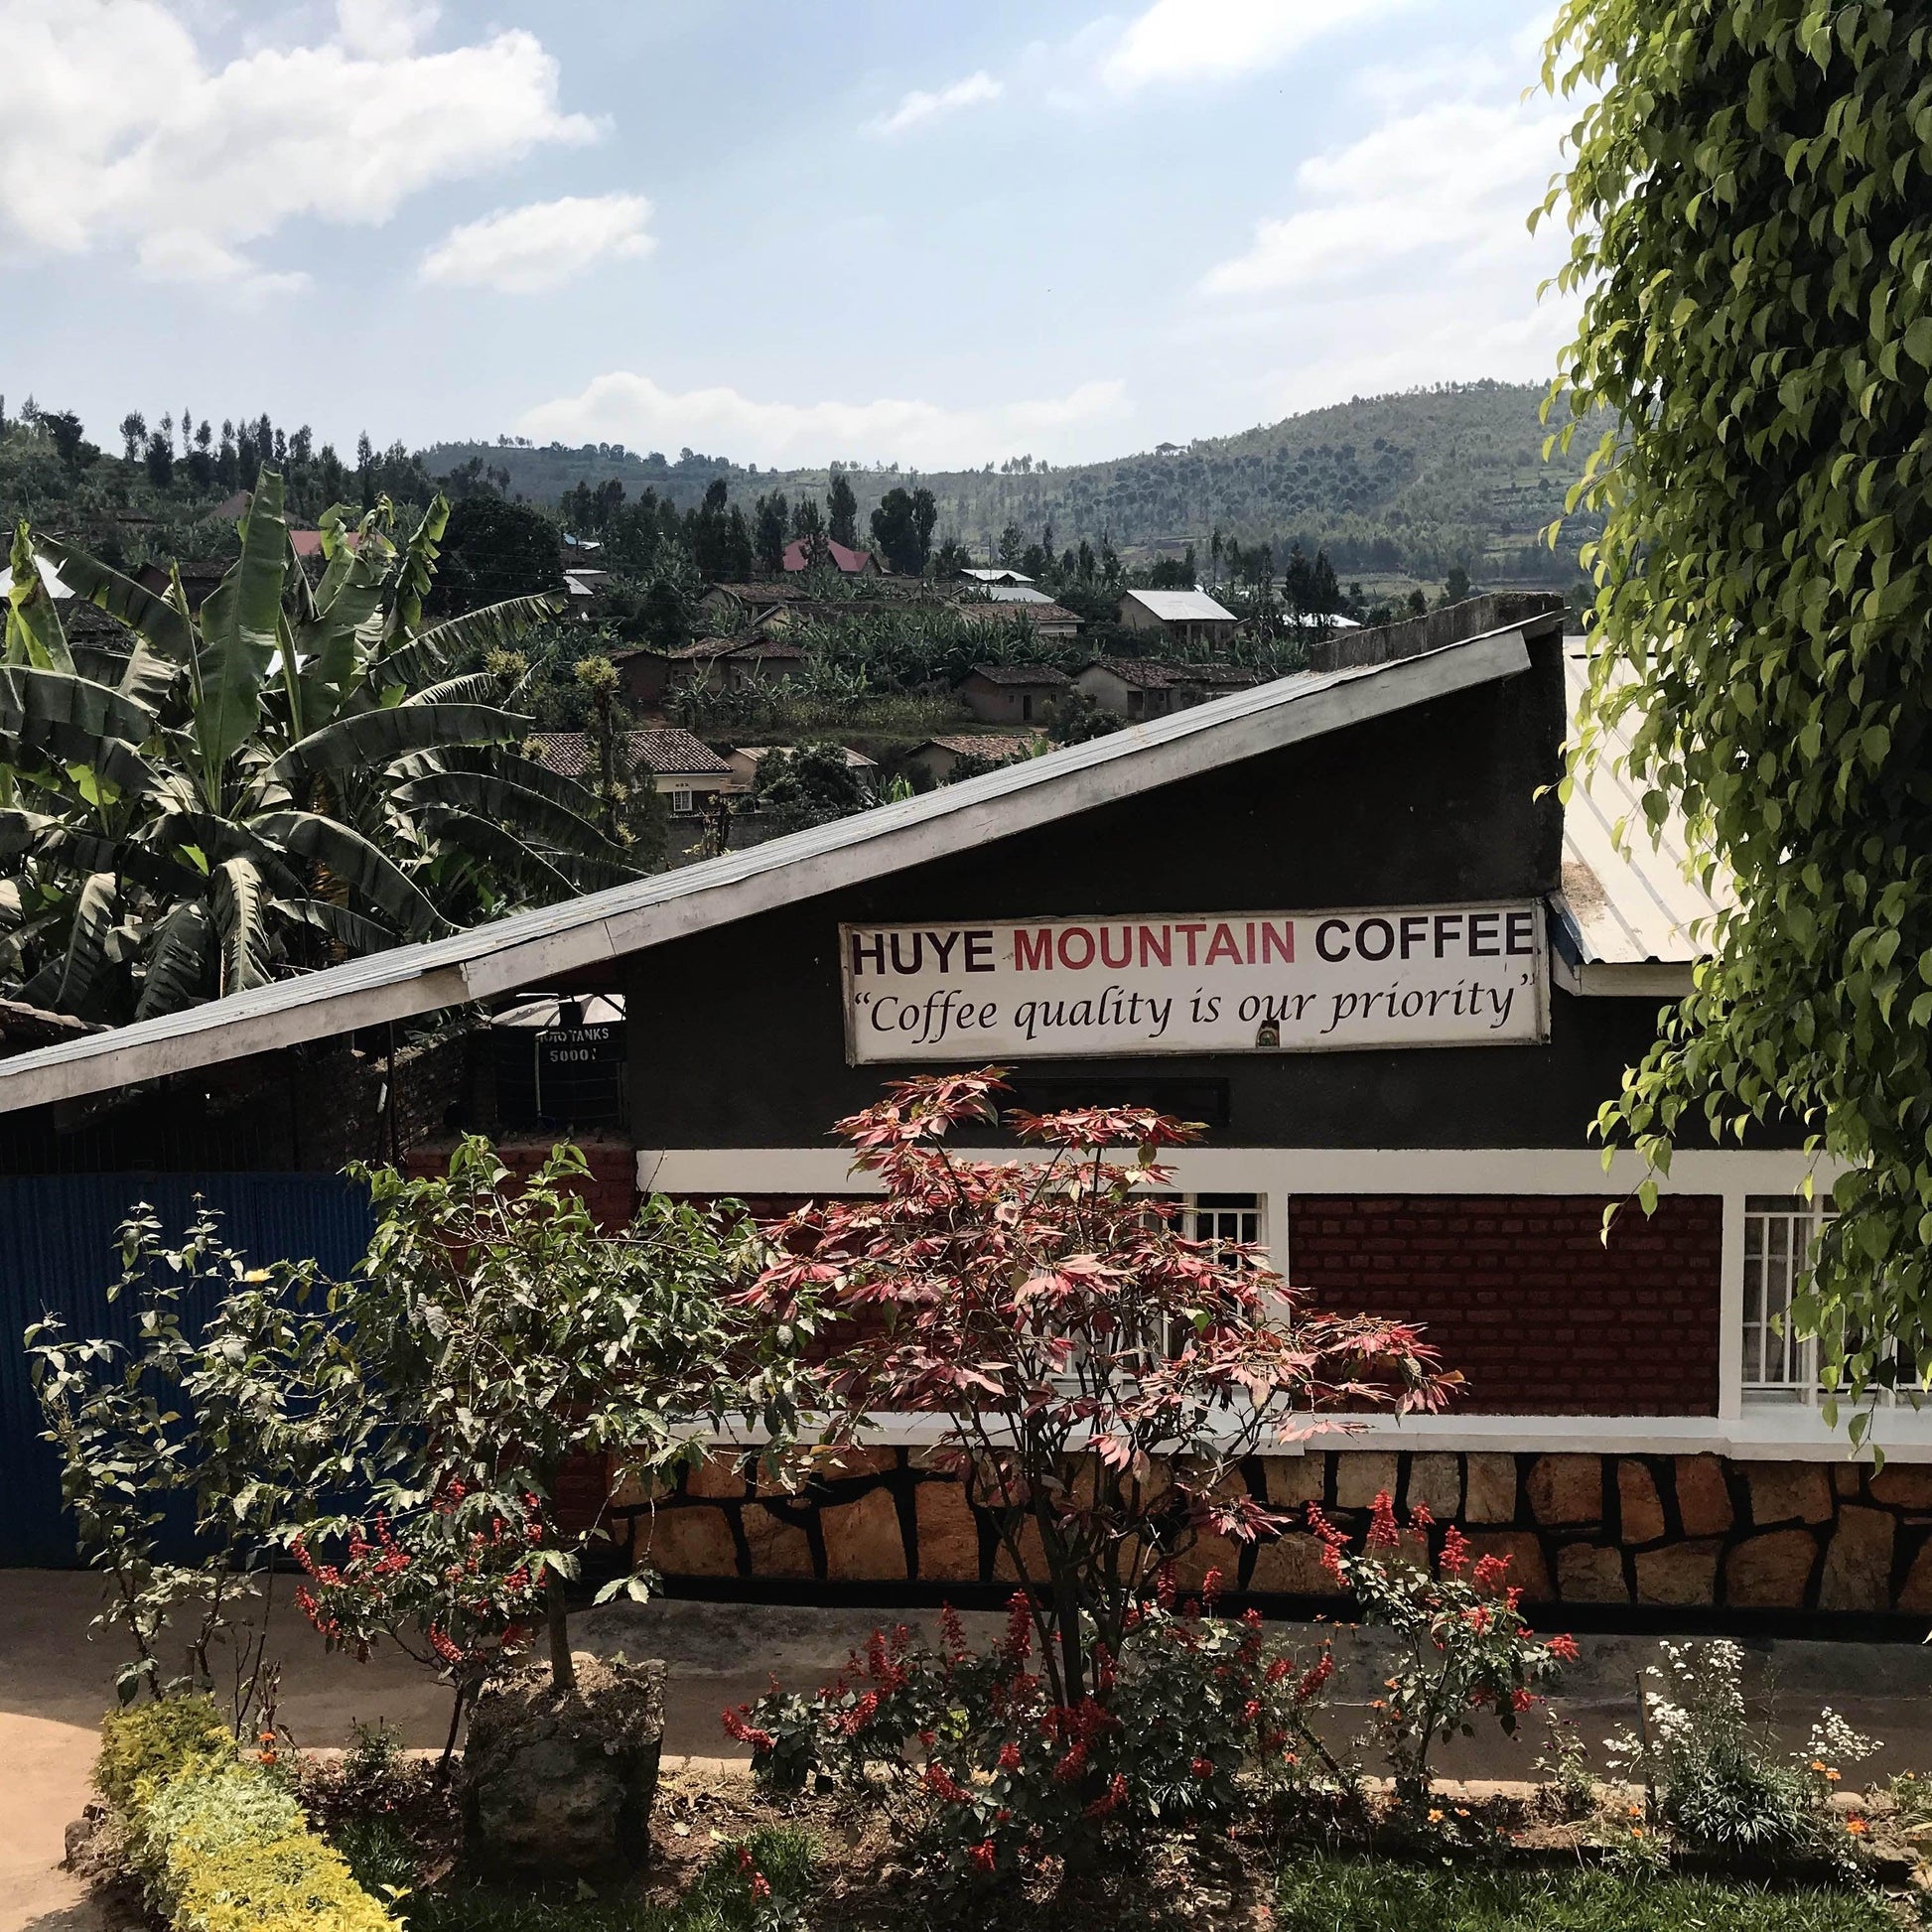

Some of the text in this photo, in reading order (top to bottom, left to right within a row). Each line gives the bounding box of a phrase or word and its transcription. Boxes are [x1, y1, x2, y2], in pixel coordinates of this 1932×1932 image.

[852, 911, 1534, 976] HUYE MOUNTAIN COFFEE
[568, 1028, 610, 1042] TANKS
[1014, 985, 1173, 1040] quality
[1189, 987, 1222, 1023] is
[1238, 992, 1316, 1023] our
